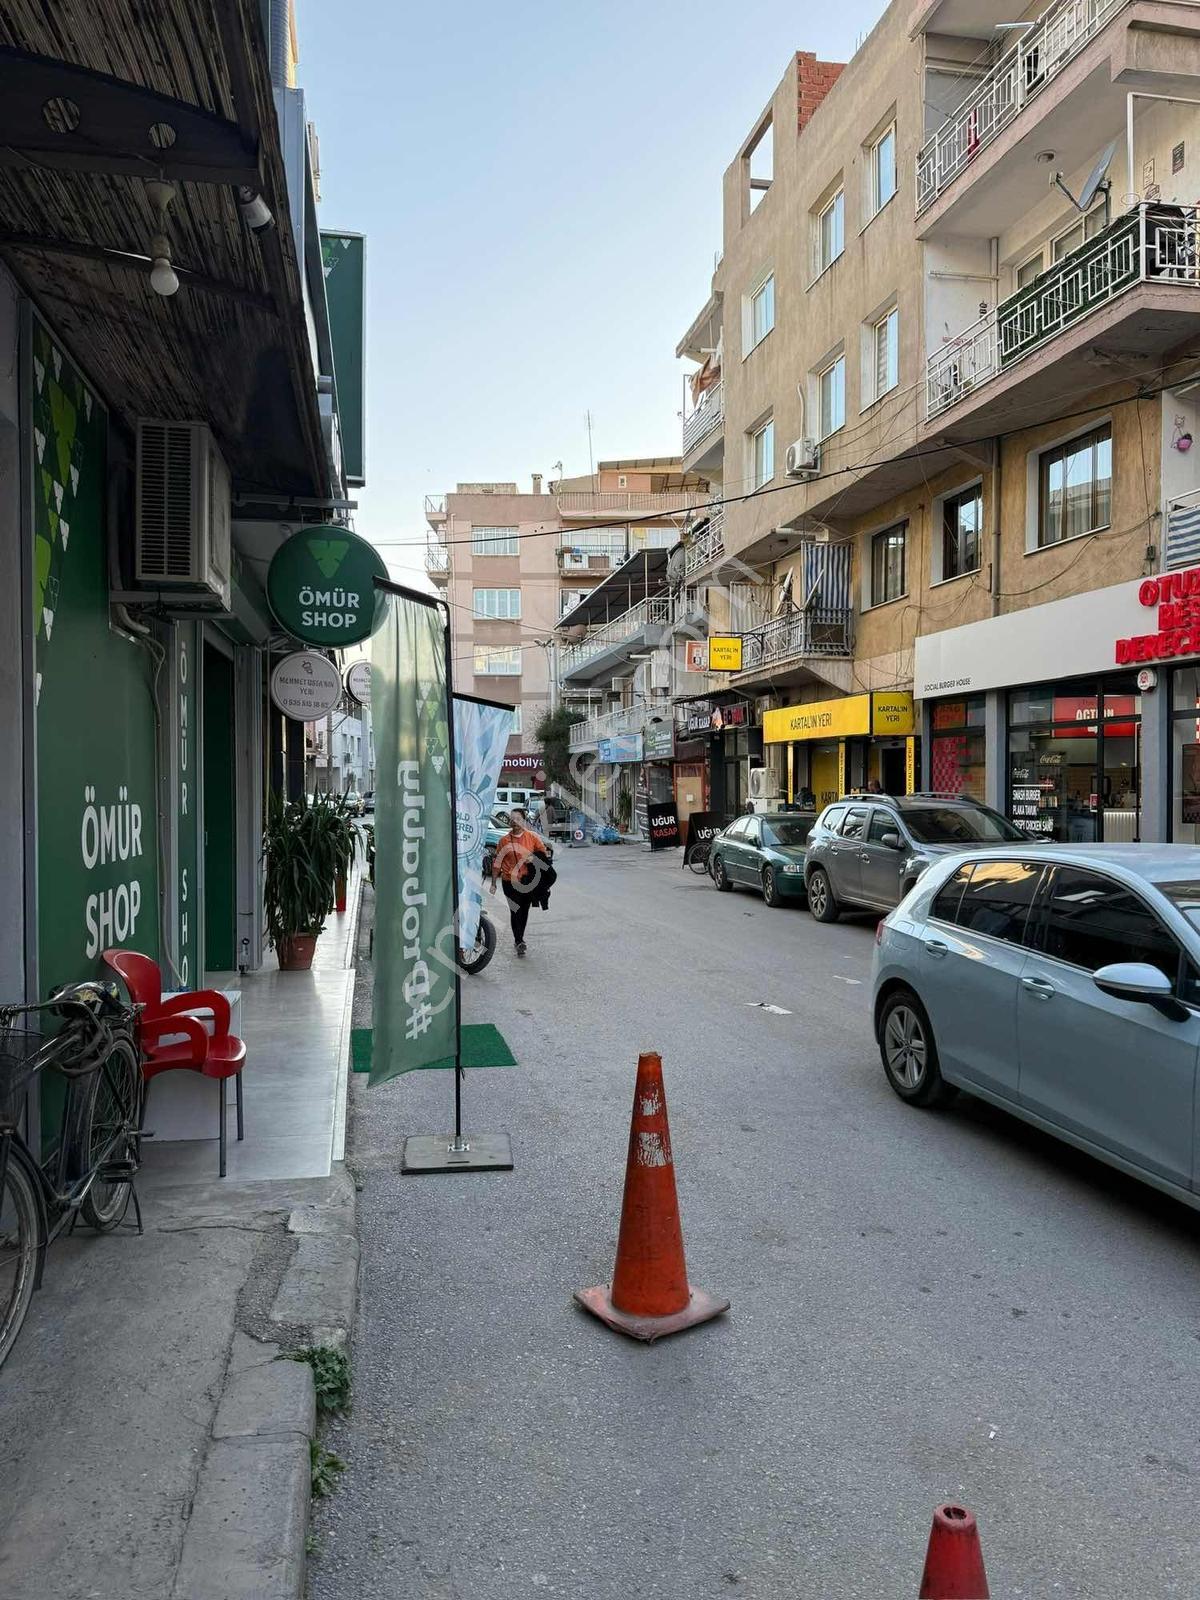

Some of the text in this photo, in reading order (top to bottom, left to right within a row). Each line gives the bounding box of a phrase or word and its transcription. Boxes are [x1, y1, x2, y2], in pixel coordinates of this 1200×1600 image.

[298, 586, 360, 609] ÖMÜR
[301, 611, 357, 628] SHOP
[924, 677, 972, 691] SOCIAL BURGER HOUSE
[1076, 708, 1114, 721] ACTIN
[179, 641, 189, 815] ÖMÜR
[821, 792, 839, 804] KARTA
[455, 811, 470, 822] OLD
[651, 815, 676, 827] UĞUR
[81, 785, 143, 870] ÖMÜR
[653, 826, 678, 838] KASAP
[85, 880, 141, 960] SHOP
[181, 869, 189, 987] SHO
